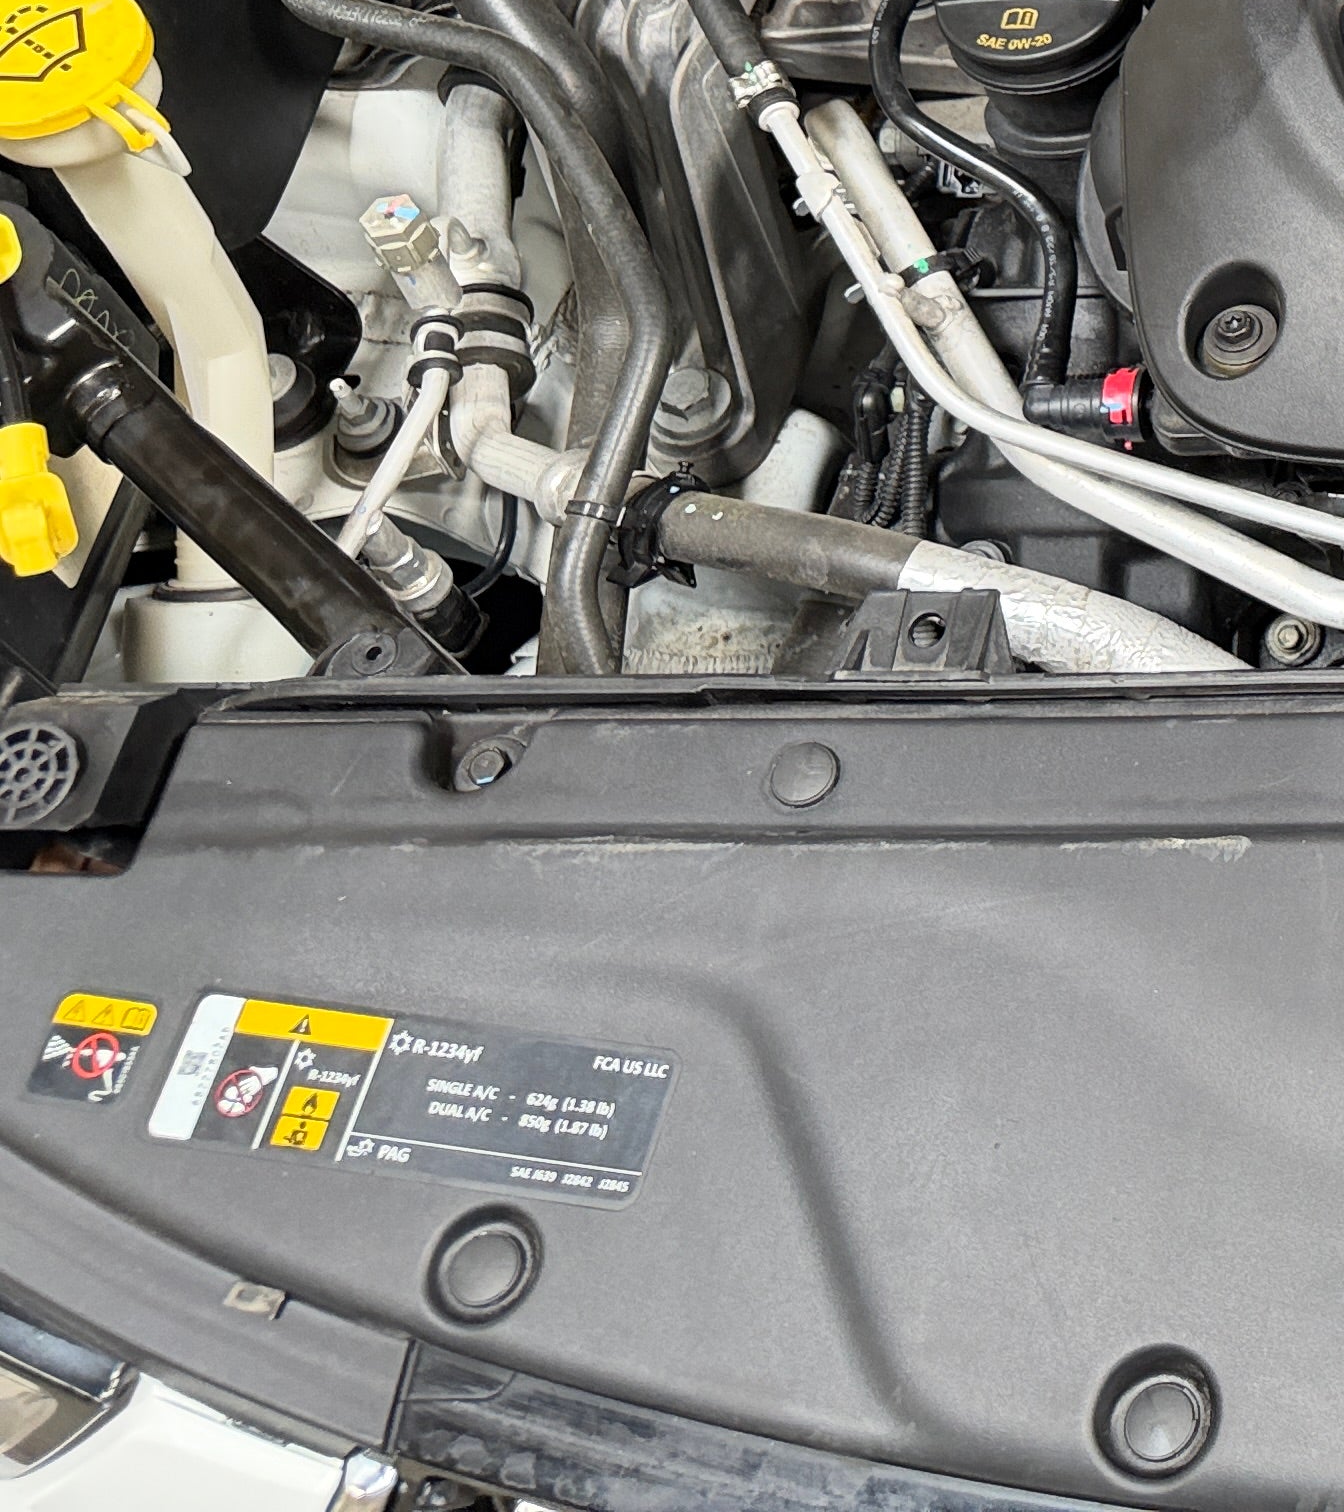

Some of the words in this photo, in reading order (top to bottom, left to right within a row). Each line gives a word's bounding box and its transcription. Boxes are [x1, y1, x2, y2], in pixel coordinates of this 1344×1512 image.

[976, 34, 1006, 50] SAE
[1008, 33, 1053, 50] 0W-20
[412, 1038, 484, 1064] R-1234yf
[592, 1055, 621, 1073] FCA
[622, 1059, 643, 1076] US
[644, 1061, 670, 1079] LLC
[425, 1078, 472, 1097] SINGLE
[473, 1084, 500, 1101] A/C
[526, 1092, 559, 1111] 624g
[591, 1099, 616, 1120] lb)
[428, 1101, 464, 1120] DUAL
[465, 1106, 493, 1123] A/C
[518, 1113, 552, 1133] 850g
[588, 1122, 609, 1141] lb)
[377, 1145, 411, 1163] PAG
